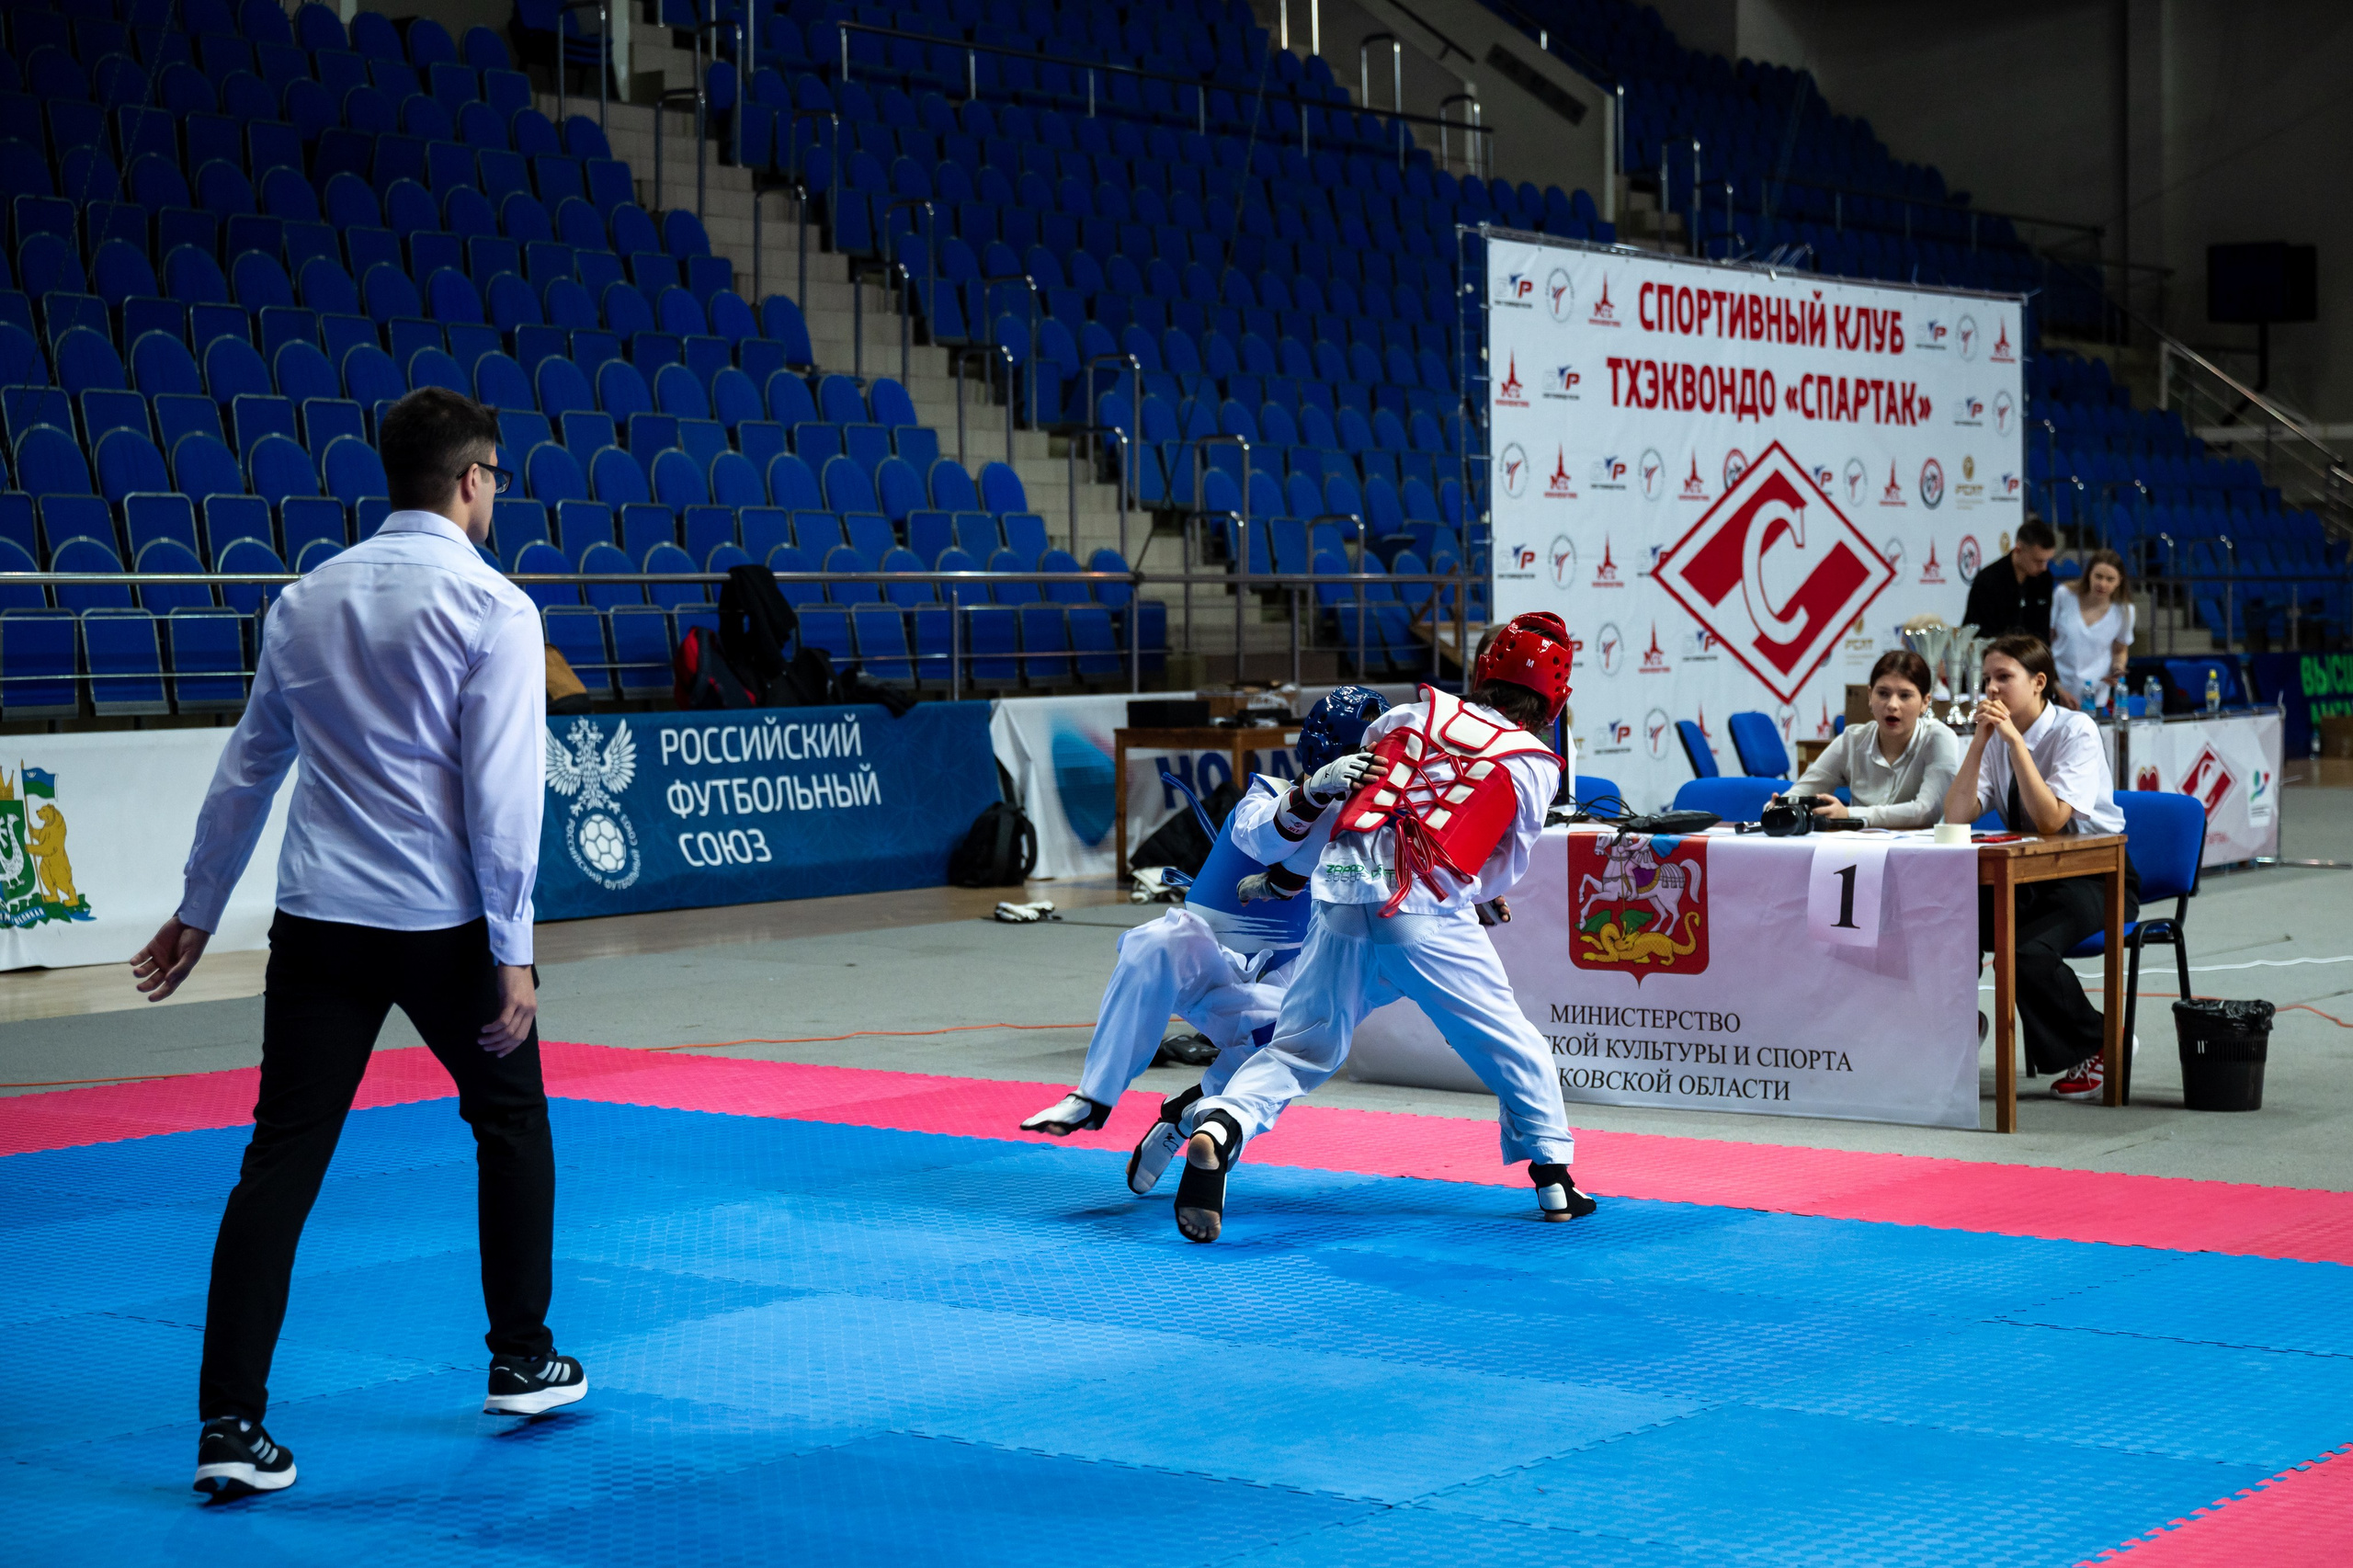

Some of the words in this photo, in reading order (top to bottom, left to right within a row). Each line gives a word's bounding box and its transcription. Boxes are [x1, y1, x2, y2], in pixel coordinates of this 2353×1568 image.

[1639, 281, 1826, 348] СПОРТИВНЫЙ
[1834, 303, 1904, 355] КЛУБ
[1607, 357, 1776, 424] ТХЭКВОНДО
[1785, 372, 1932, 426] «СПАРТАК»
[1526, 658, 1535, 668] M
[661, 713, 862, 766] РОССИЙСКИЙ
[666, 762, 882, 819] ФУТБОЛЬНЫЙ
[565, 818, 603, 884] РОССИЙСКИЙ
[620, 813, 638, 846] СОЮЗ
[678, 828, 773, 868] СОЮЗ
[1830, 864, 1861, 929] 1
[1550, 1004, 1741, 1033] МИНИСТЕРСТВО
[1605, 1040, 1727, 1066] КУЛЬТУРЫ
[1734, 1046, 1750, 1066] И
[1756, 1046, 1853, 1073] СПОРТА
[1556, 1067, 1672, 1095] КОВСКОЙ
[1678, 1074, 1790, 1101] ОБЛАСТИ
